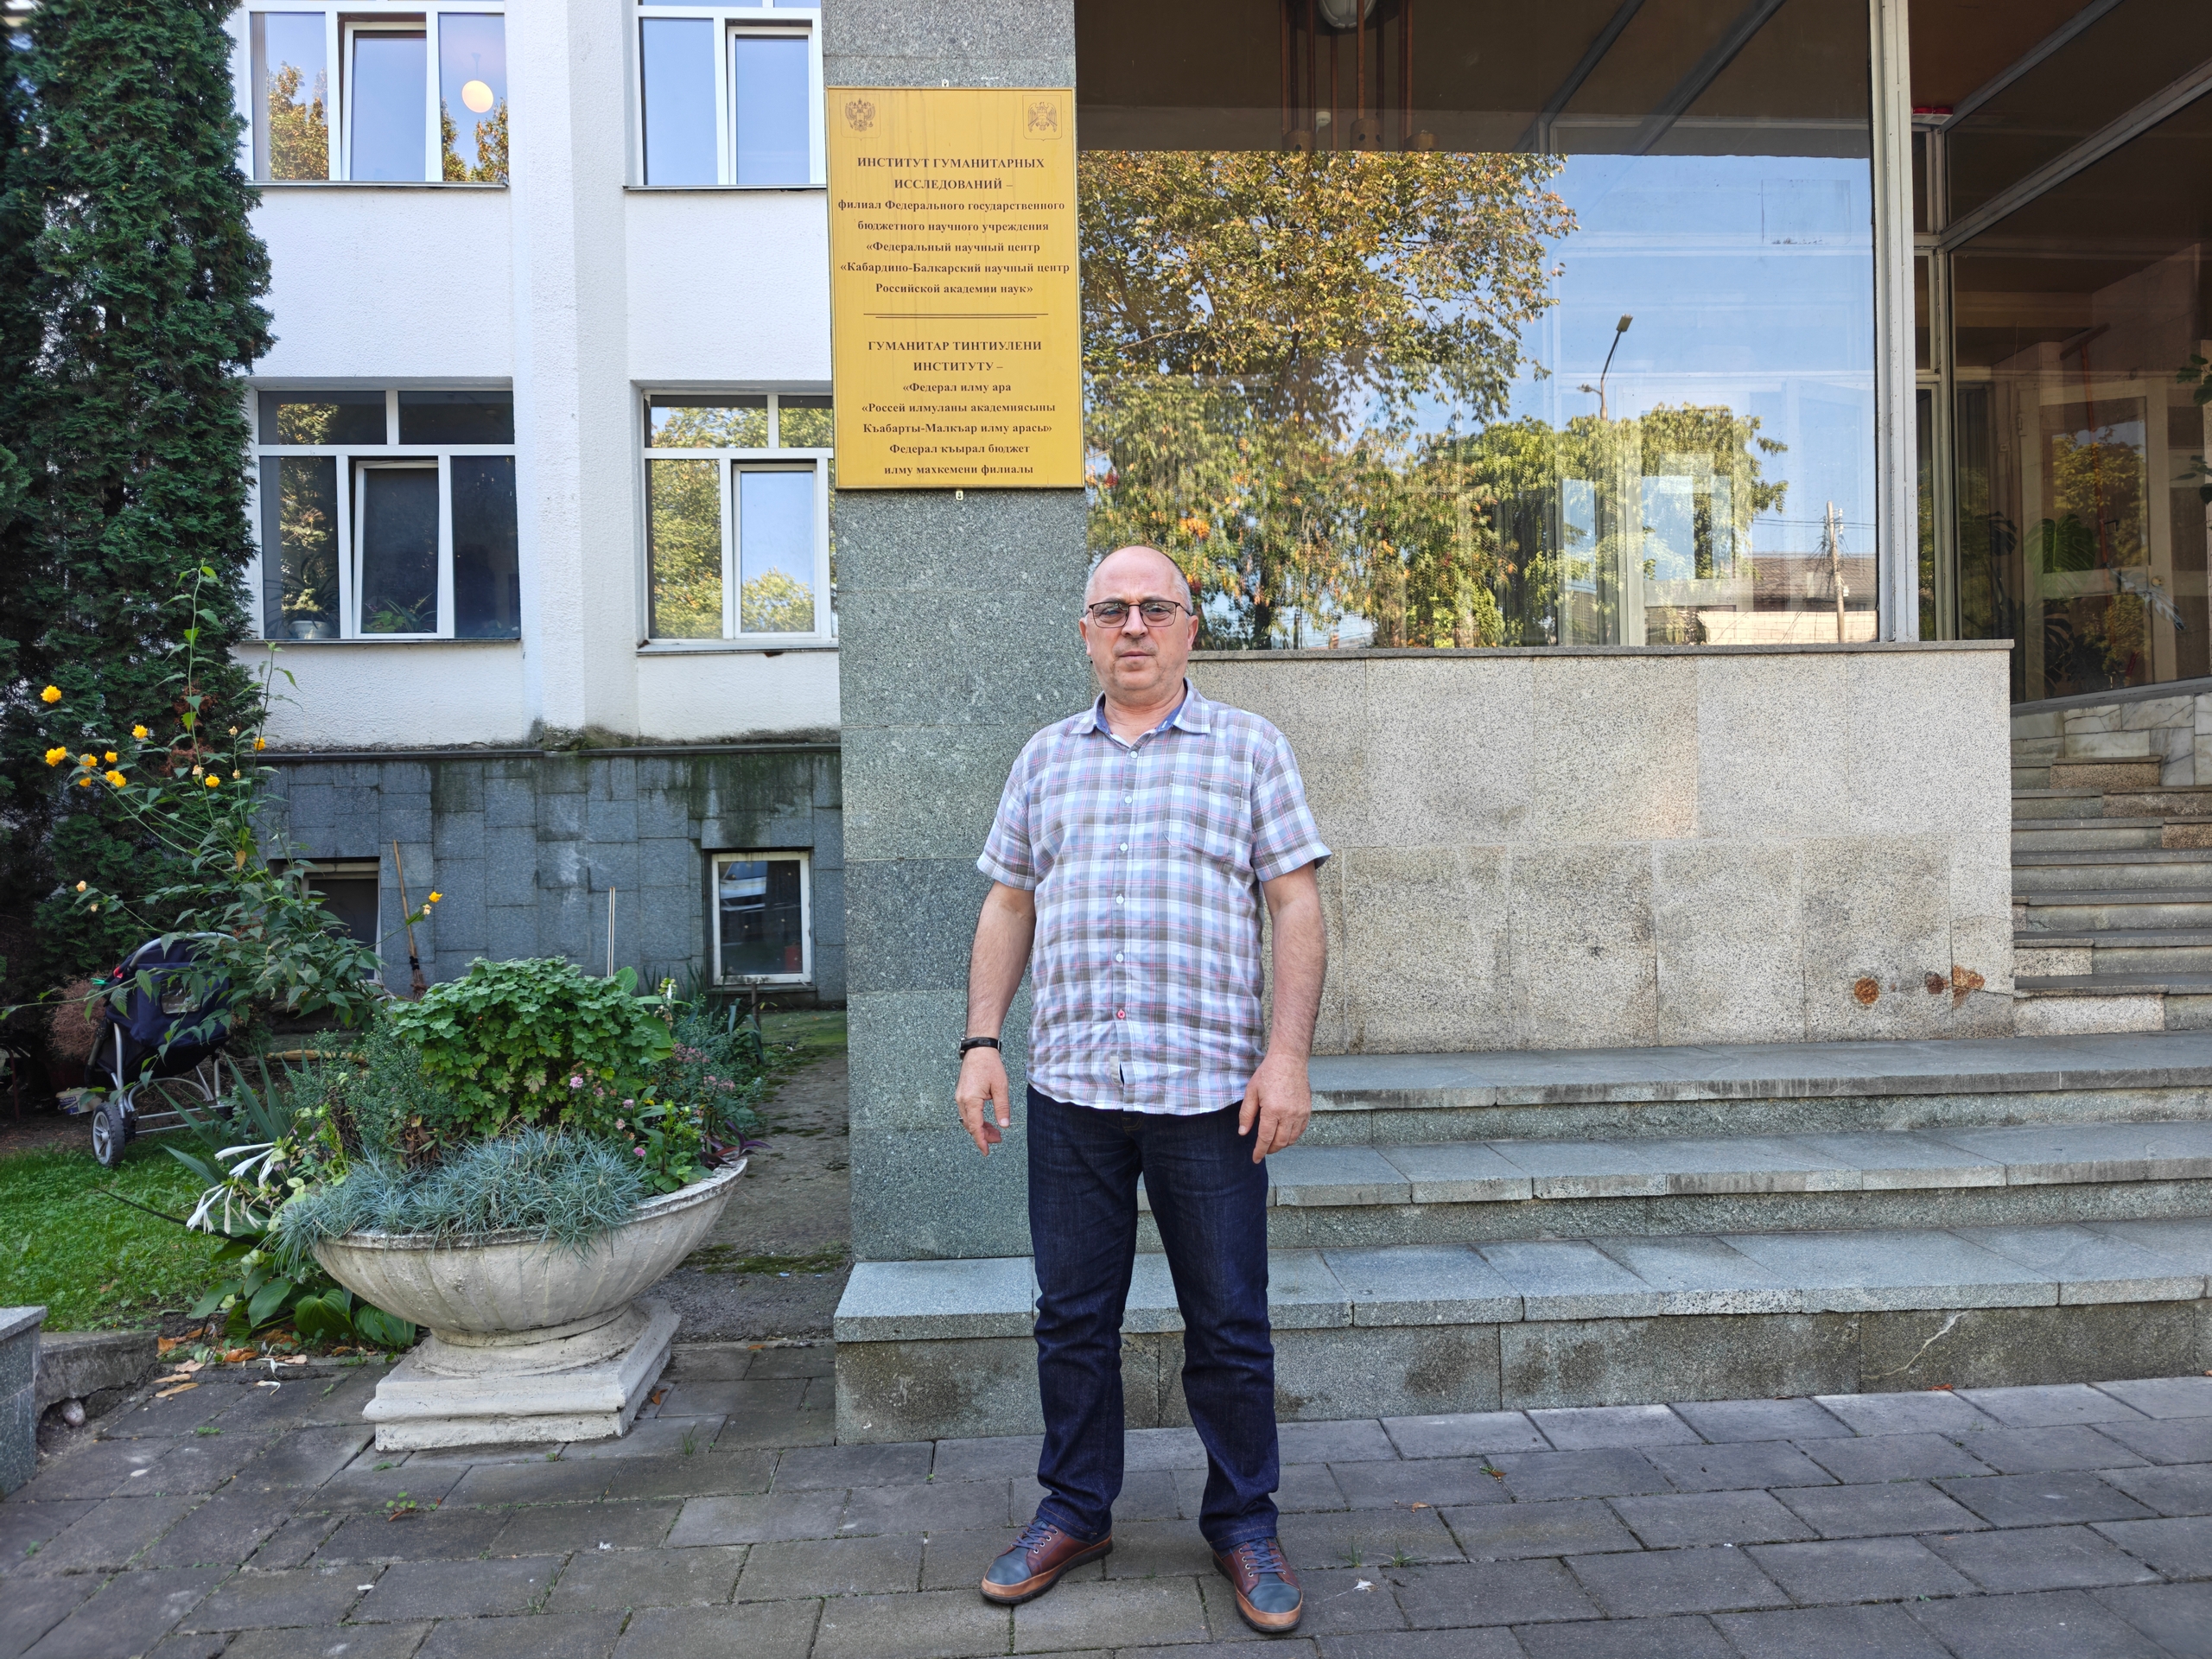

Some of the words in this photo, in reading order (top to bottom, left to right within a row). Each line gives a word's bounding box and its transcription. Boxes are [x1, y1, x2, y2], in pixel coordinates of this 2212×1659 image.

[857, 157, 930, 168] ИНСТИТУТ
[933, 158, 1045, 168] ГУМАНИТАРНЫХ
[894, 177, 1002, 191] ИССЛЕДОВАНИЙ
[837, 199, 881, 212] филиал
[884, 200, 965, 213] Федерального
[968, 202, 1065, 213] государственного
[857, 220, 925, 231] бюджетного
[928, 223, 979, 234] научного
[982, 223, 1049, 234] учреждения
[866, 241, 951, 254] «Федеральный
[955, 242, 1004, 255] научный
[1007, 244, 1040, 254] центр
[840, 262, 981, 276] «Кабардино-Балкарский
[984, 263, 1033, 276] научный
[1037, 264, 1070, 275] центр
[875, 283, 940, 294] Российской
[944, 284, 997, 295] академии
[1000, 284, 1033, 296] наук»
[868, 340, 950, 351] ГУМАНИТАР
[953, 340, 1042, 351] ТИНТИУЛЕНИ
[913, 361, 994, 372] ИНСТИТУТУ
[902, 382, 957, 395] «Федерал
[960, 385, 989, 394] илму
[992, 384, 1012, 394] ара
[861, 403, 906, 413] «Россей
[909, 404, 968, 415] илмуланы
[970, 404, 1056, 413] академиясыны
[862, 423, 978, 435] Къабарты-Малкъар
[981, 425, 1009, 435] илму
[1012, 425, 1052, 435] арасы»
[889, 443, 938, 456] Федерал
[939, 446, 985, 455] къырал
[988, 443, 1031, 454] бюджет
[884, 467, 913, 477] илму
[981, 464, 1033, 476] филиалы
